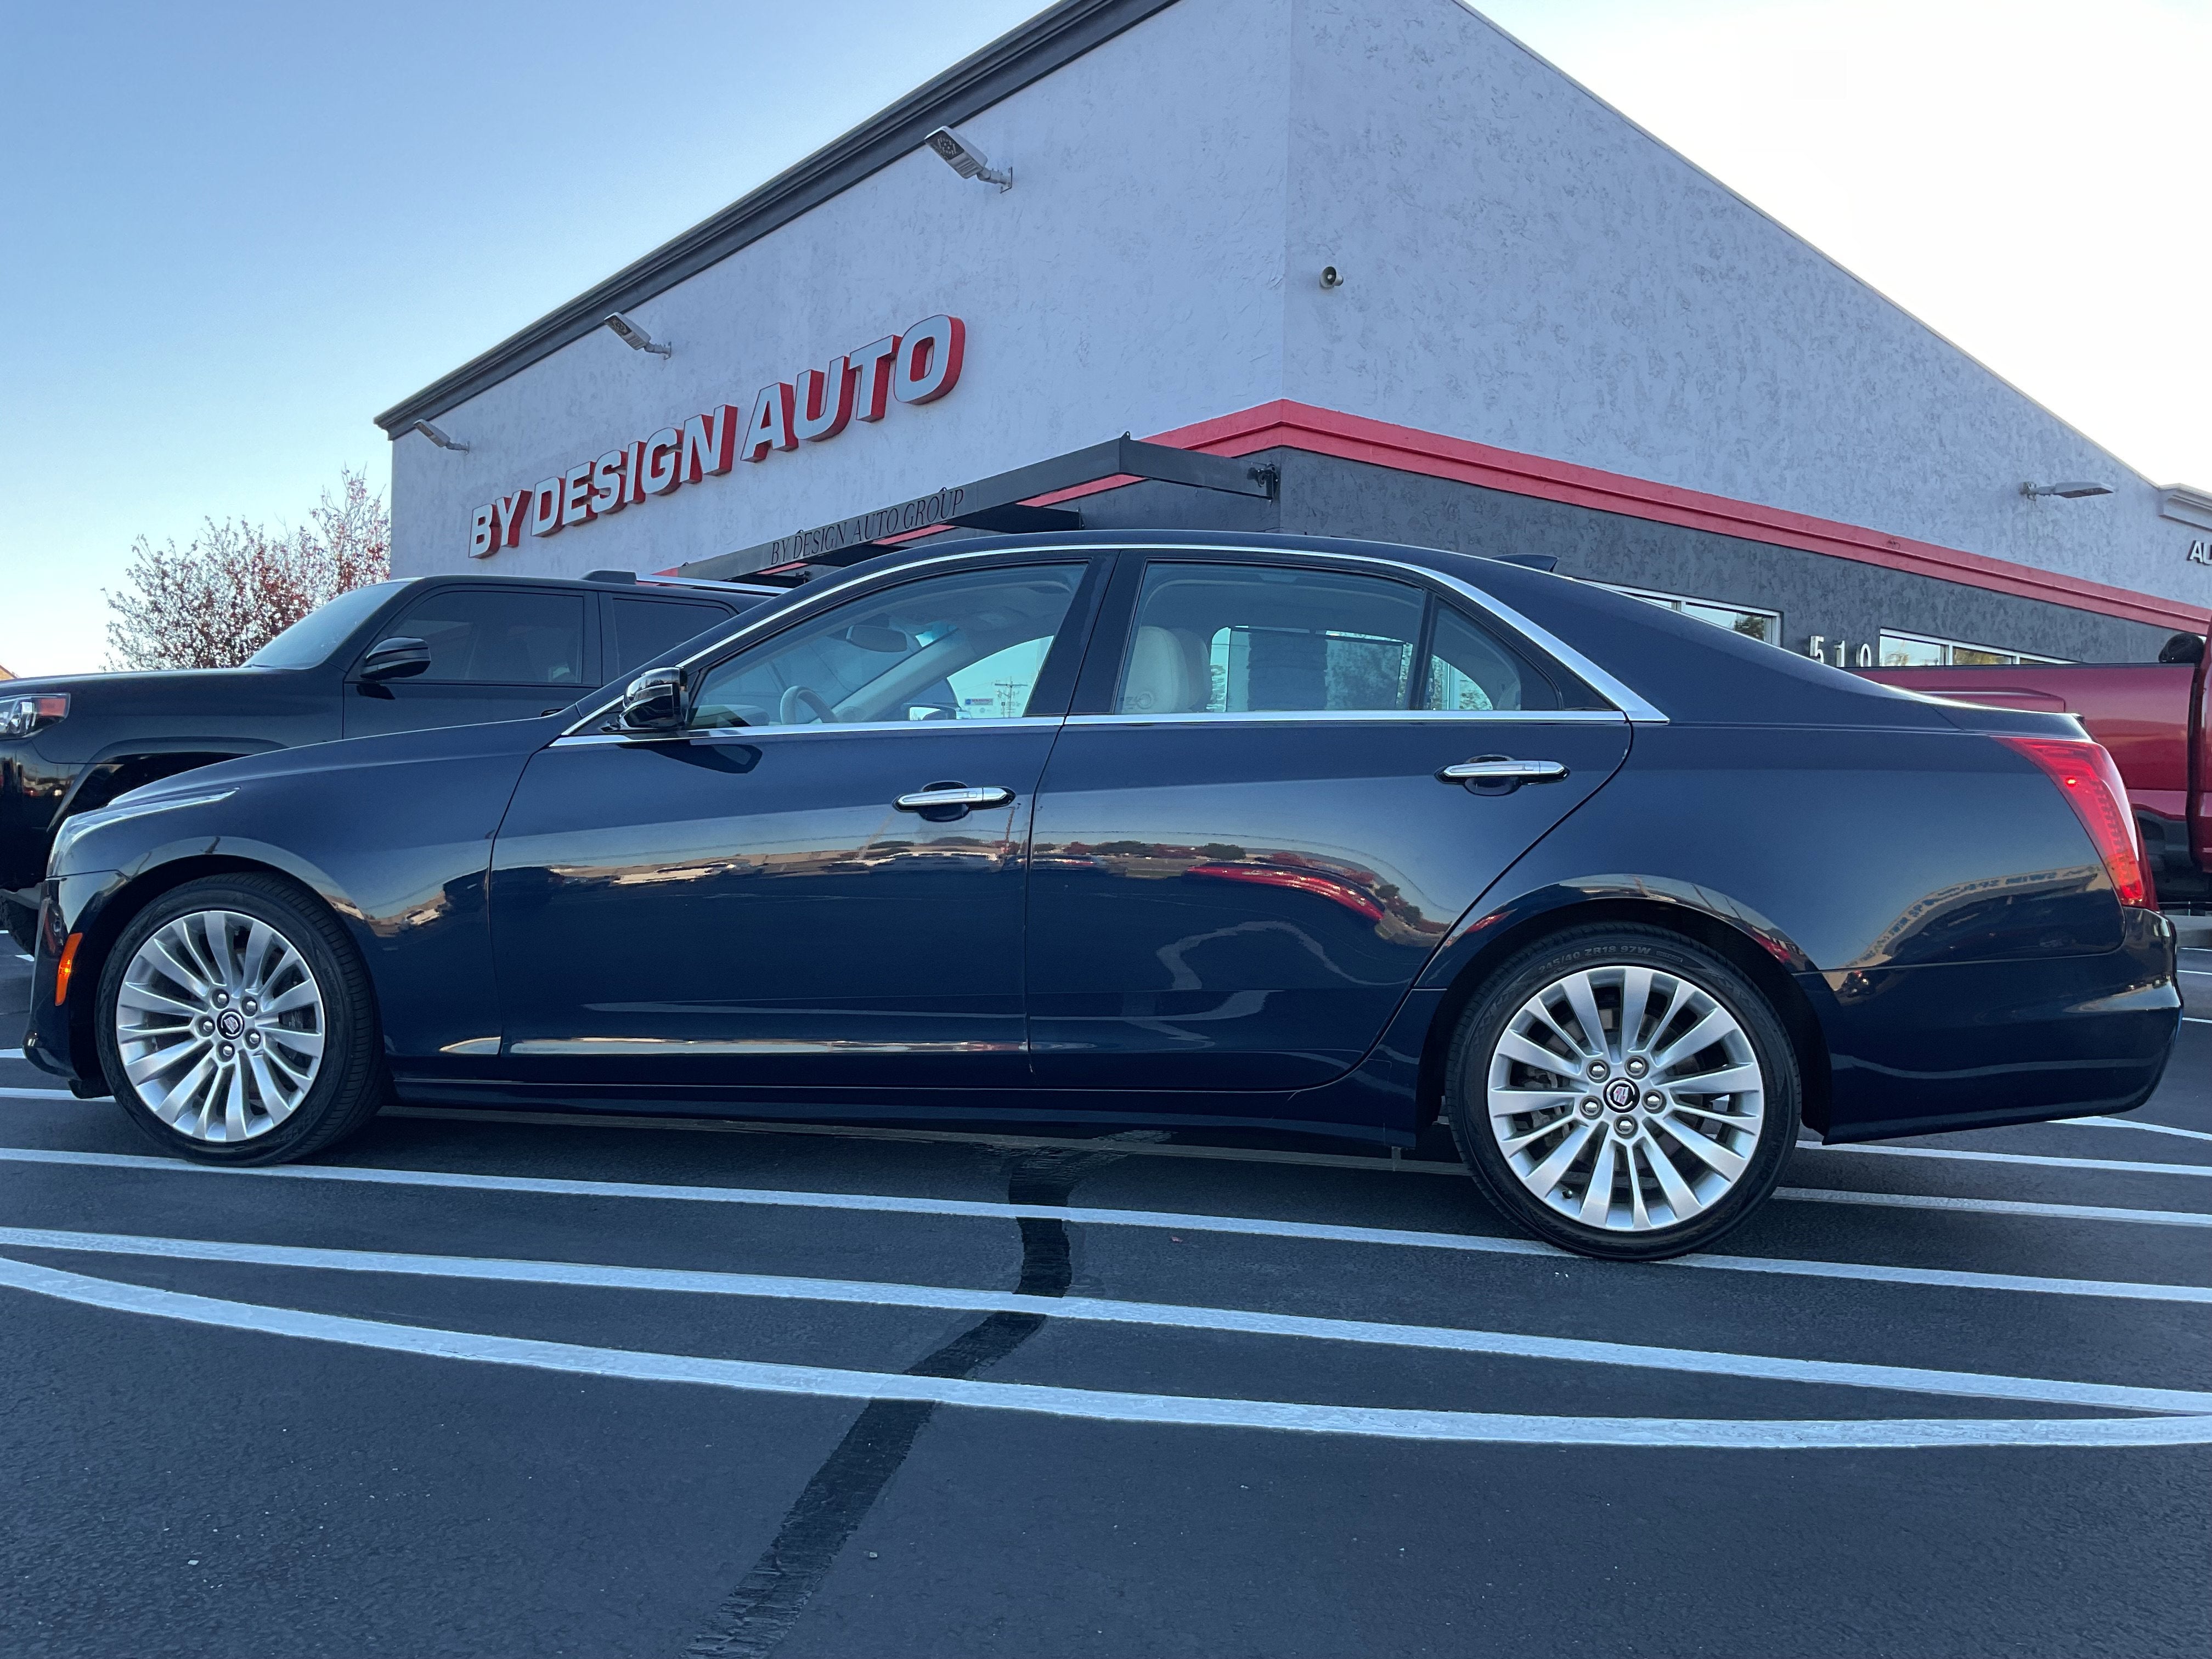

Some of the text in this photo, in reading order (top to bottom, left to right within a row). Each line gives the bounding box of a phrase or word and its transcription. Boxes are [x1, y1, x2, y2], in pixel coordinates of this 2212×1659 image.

[468, 314, 966, 558] BY DESIGN AUTO
[771, 489, 964, 565] BY DESIGN AUTO GROUP
[1538, 951, 1581, 974] 245/40
[1584, 945, 1617, 956] ZR18
[1620, 945, 1651, 955] 97W
